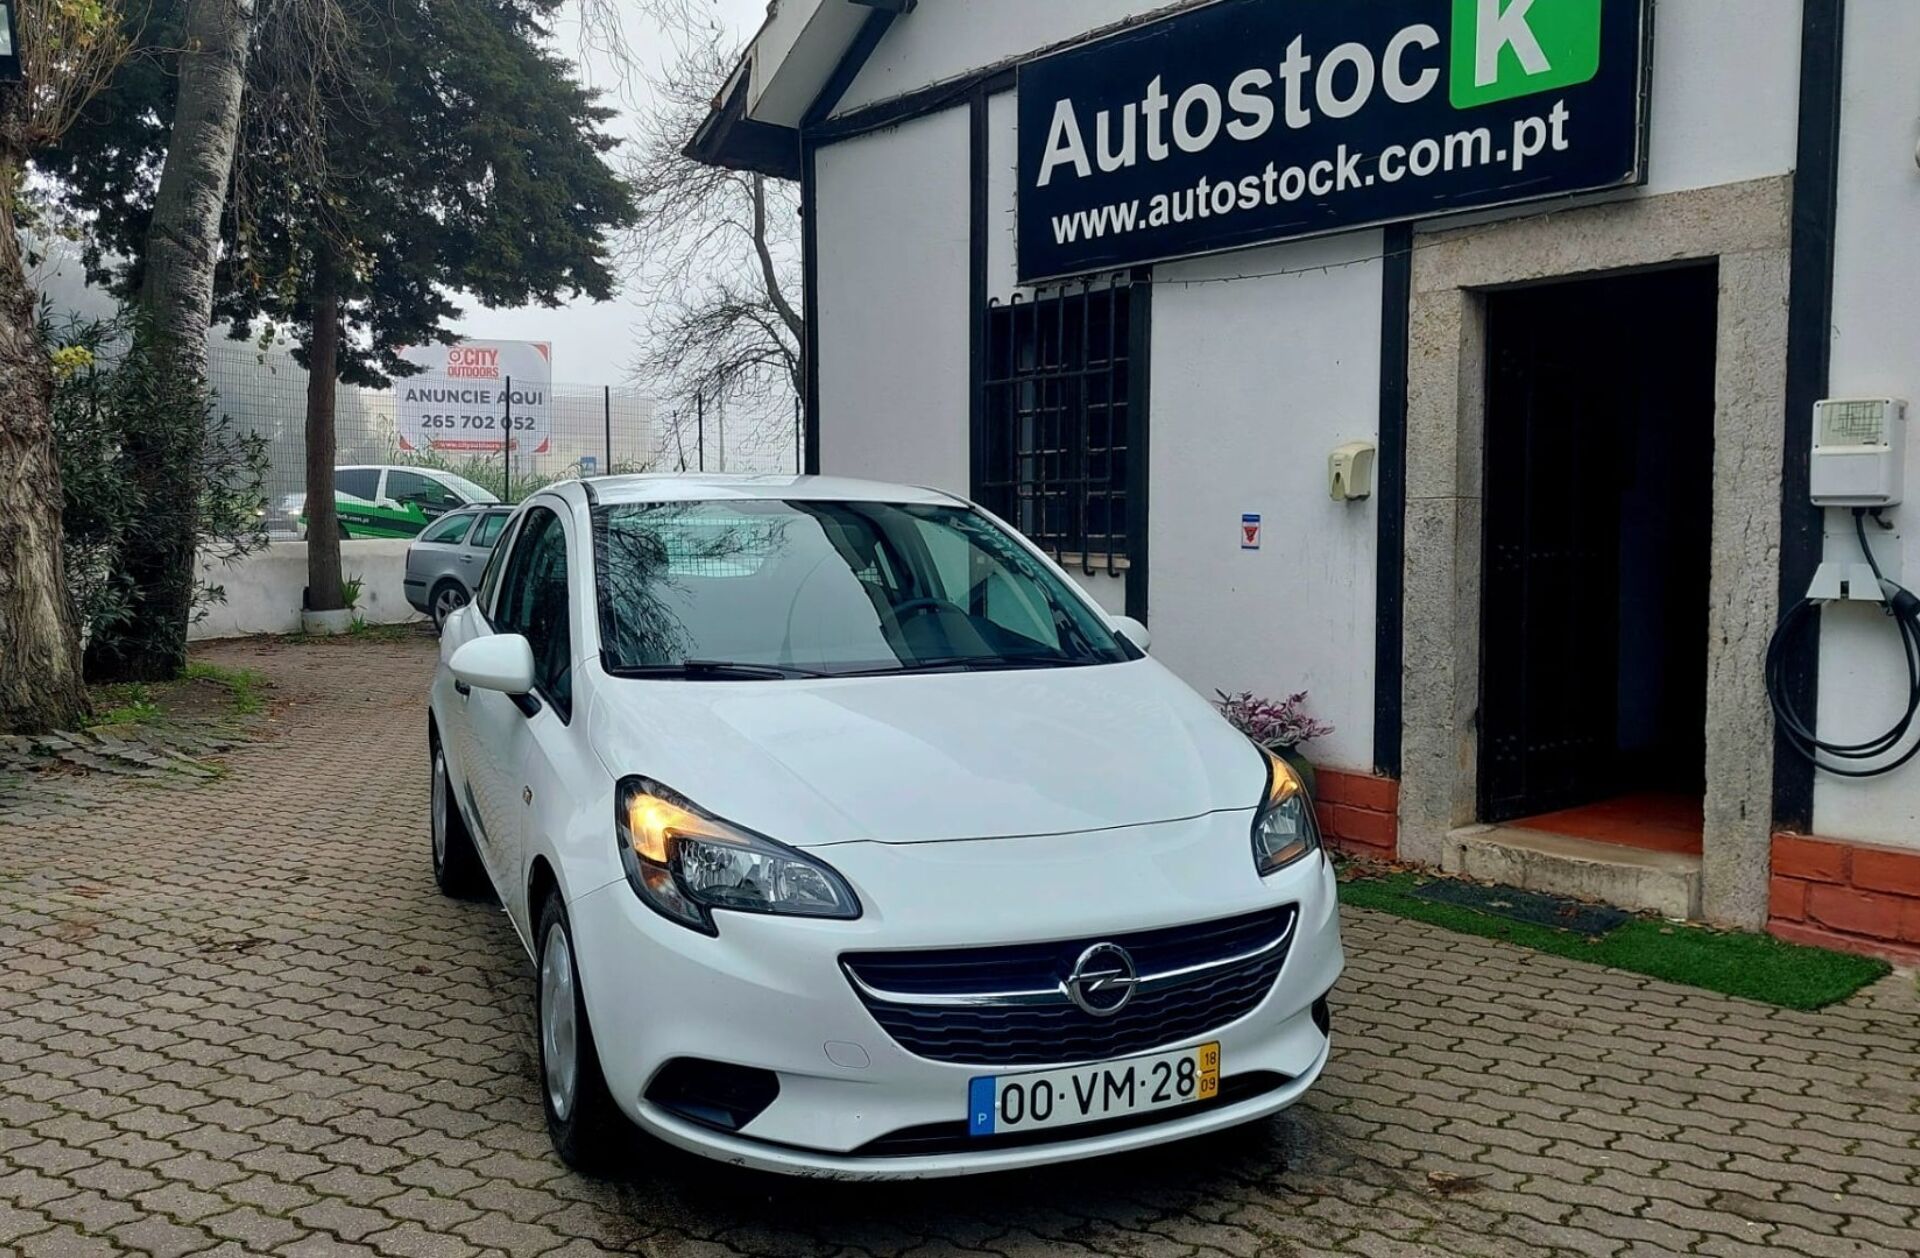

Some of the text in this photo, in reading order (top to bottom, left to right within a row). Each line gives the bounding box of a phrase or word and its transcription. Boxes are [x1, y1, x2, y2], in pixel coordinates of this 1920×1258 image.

[1051, 99, 1570, 245] www.autostock.com.pt
[464, 349, 498, 365] CITY
[447, 366, 499, 377] OUTDOORS
[405, 388, 542, 405] ANUNCIE AQUI
[421, 414, 536, 431] 265 702 052
[1204, 1051, 1217, 1066] 18
[1200, 1076, 1217, 1092] 09
[977, 1112, 988, 1126] P
